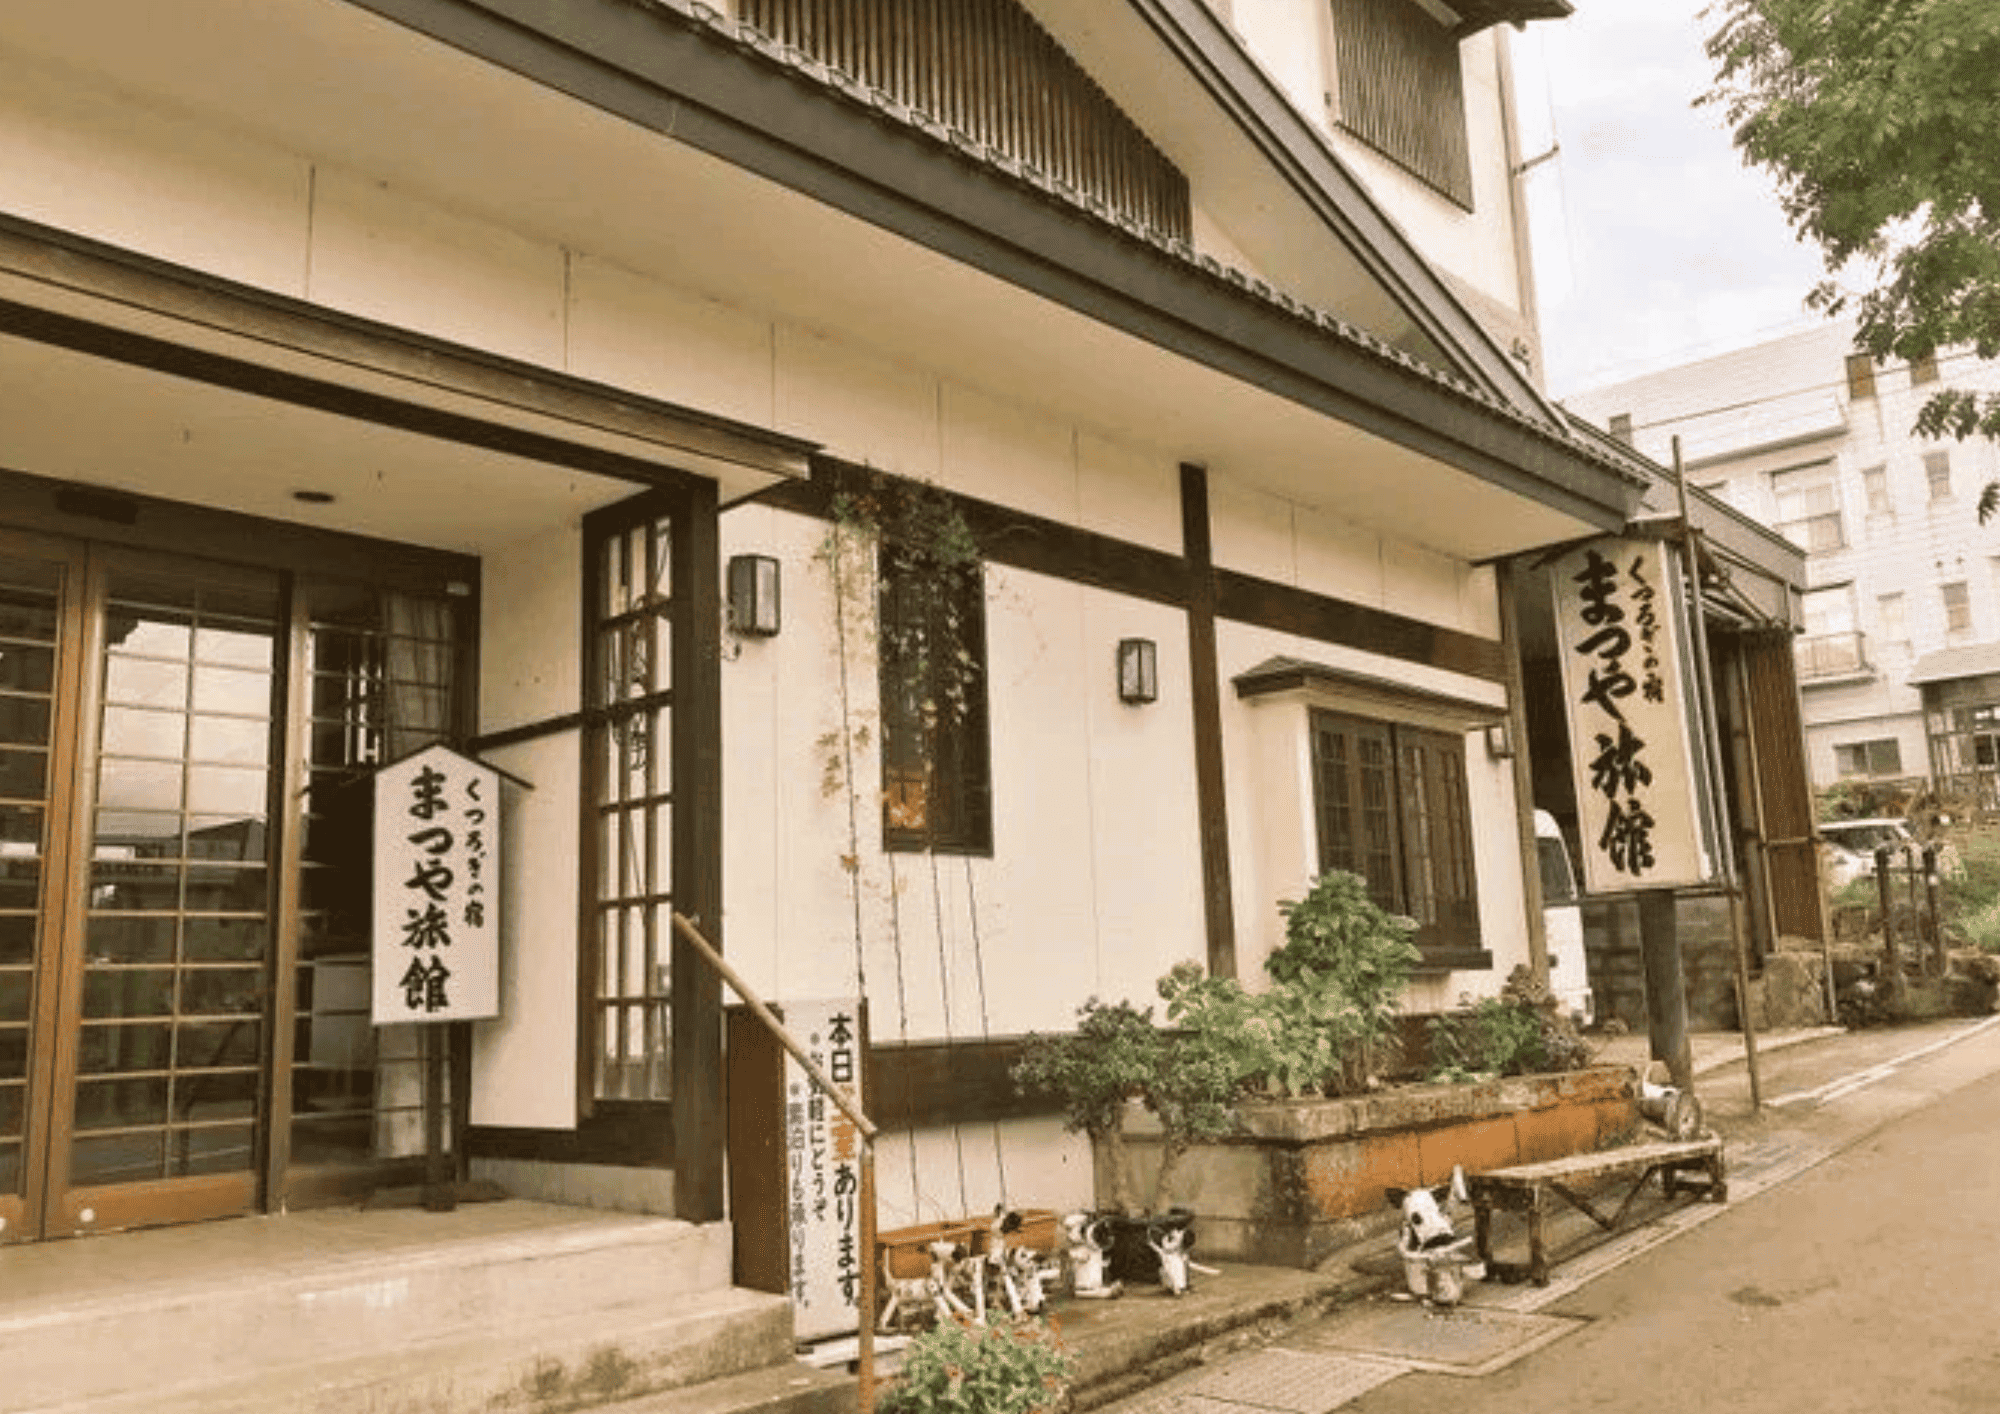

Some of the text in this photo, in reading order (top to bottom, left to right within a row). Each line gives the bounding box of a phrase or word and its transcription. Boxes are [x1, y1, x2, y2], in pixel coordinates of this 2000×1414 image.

[1572, 550, 1656, 878] まつや旅館
[1629, 555, 1664, 703] くつろぎの宿
[398, 765, 454, 1013] まつや旅館
[464, 777, 486, 928] くつろぎの宿
